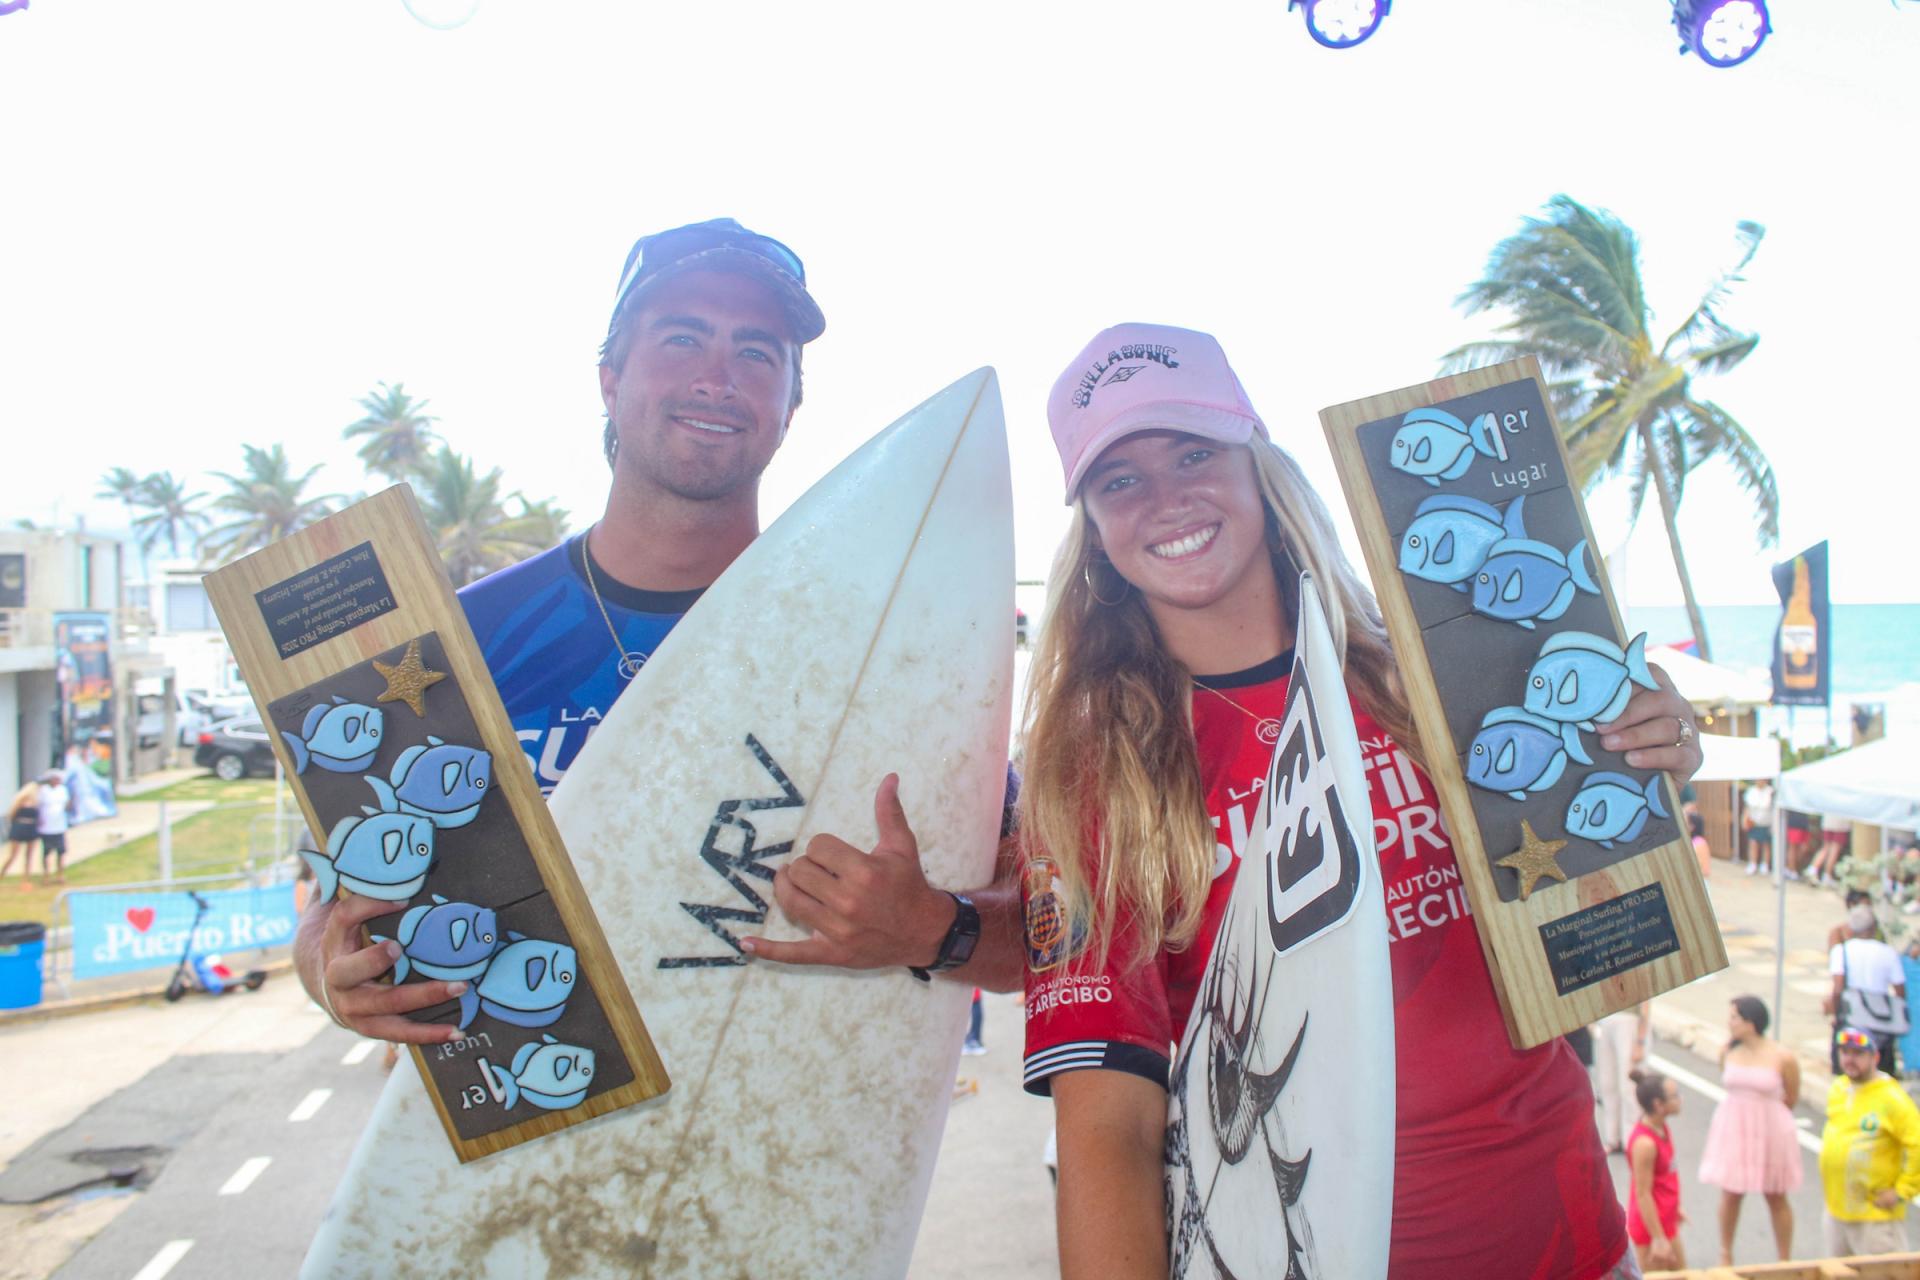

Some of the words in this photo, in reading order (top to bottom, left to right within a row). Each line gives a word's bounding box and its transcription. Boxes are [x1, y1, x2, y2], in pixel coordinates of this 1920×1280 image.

[1072, 344, 1179, 408] BILLABONG
[1483, 410, 1528, 461] 1er
[1491, 463, 1546, 488] Lugar
[379, 596, 390, 606] La
[345, 602, 379, 624] Marginal
[316, 617, 345, 633] Surfing
[298, 629, 317, 645] PRO
[561, 706, 602, 722] LA
[1545, 928, 1556, 938] La
[1556, 913, 1592, 933] Marginal
[1592, 904, 1622, 918] Surfing
[1622, 894, 1641, 908] PRO
[92, 922, 224, 962] Puerto
[230, 912, 291, 945] Rico
[1579, 966, 1604, 979] Carlos
[1036, 987, 1112, 1015] ARECIBO
